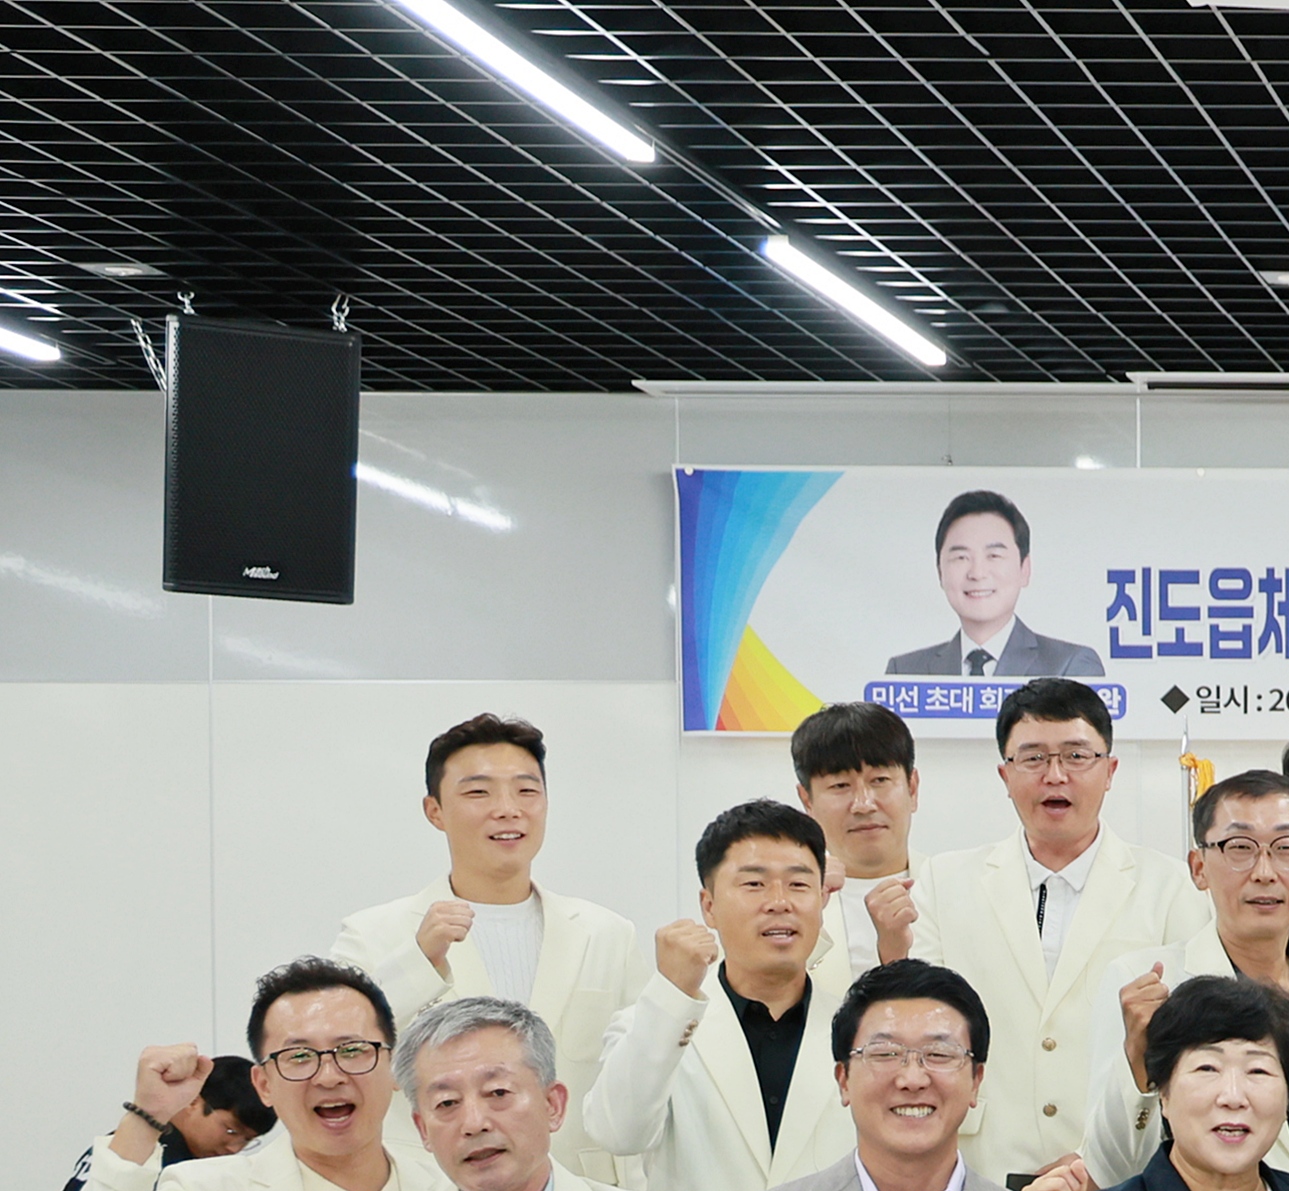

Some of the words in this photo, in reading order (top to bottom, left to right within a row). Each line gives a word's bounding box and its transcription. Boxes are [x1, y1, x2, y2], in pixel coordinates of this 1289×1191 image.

[872, 686, 919, 713] 민선
[925, 687, 973, 713] 초대
[980, 687, 1019, 713] 회
[1195, 684, 1249, 715] 일시
